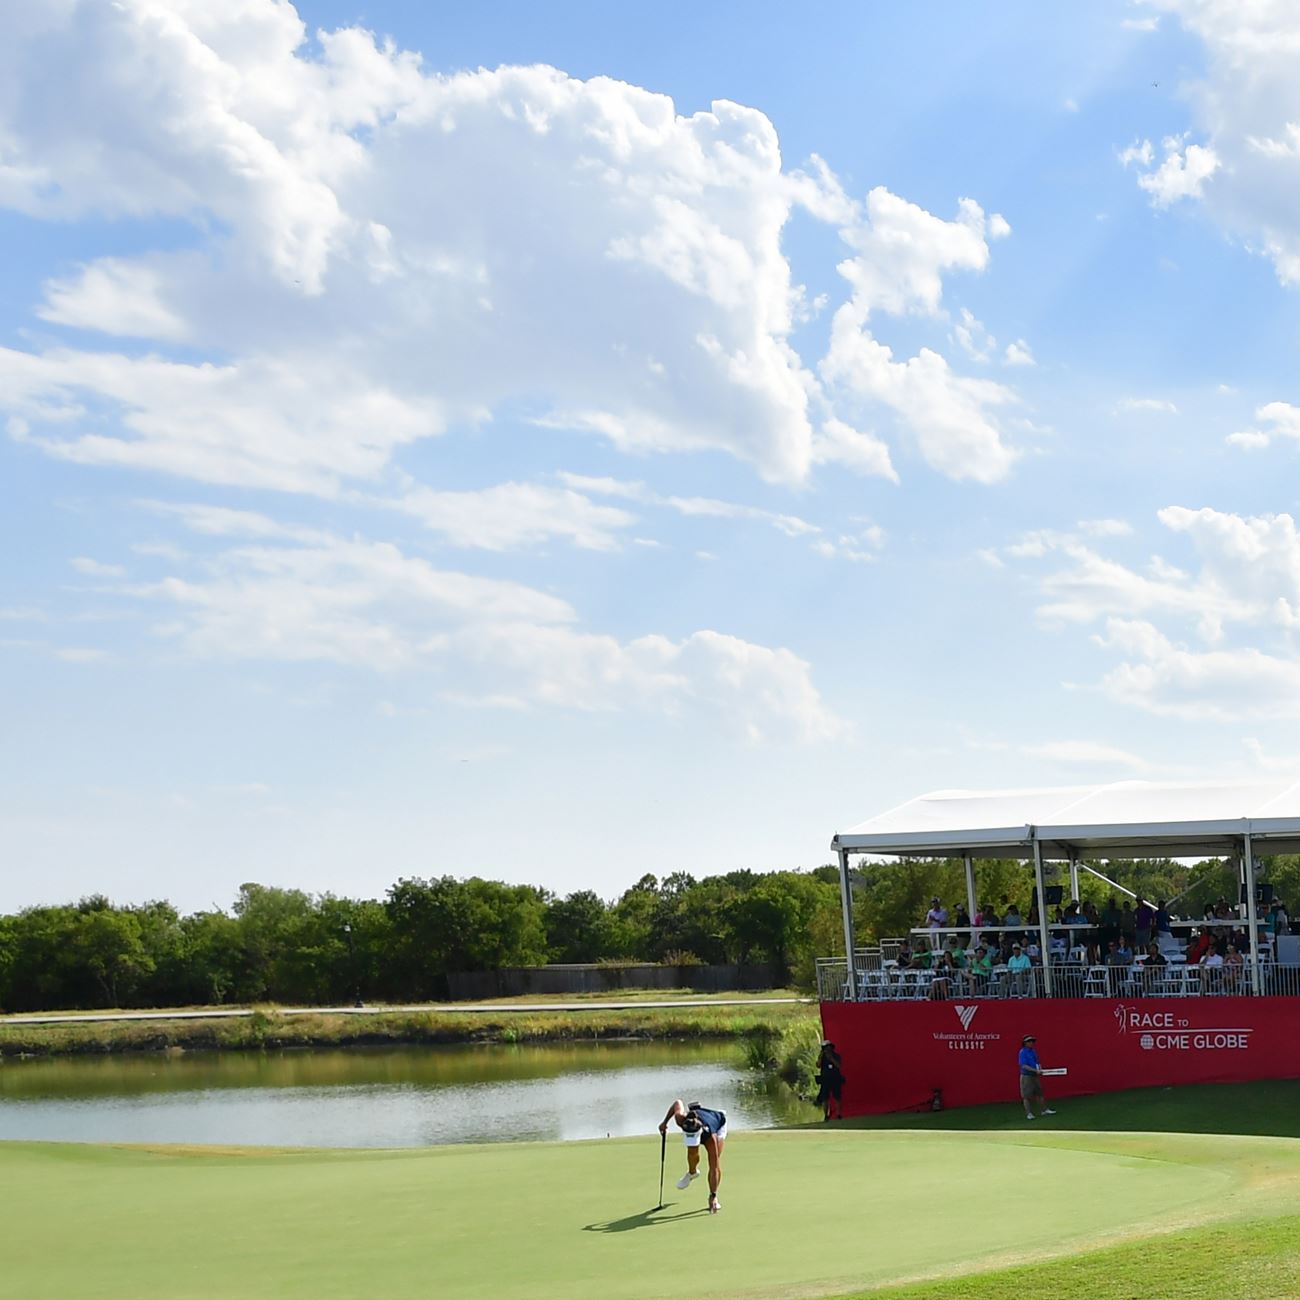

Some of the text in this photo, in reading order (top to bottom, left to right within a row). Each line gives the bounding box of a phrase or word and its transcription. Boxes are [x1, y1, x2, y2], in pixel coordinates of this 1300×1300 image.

[1130, 1013, 1189, 1027] RACE TO
[932, 1032, 966, 1040] Volunteers
[1156, 1034, 1248, 1049] CME GLOBE
[948, 1041, 985, 1050] CLASSIC
